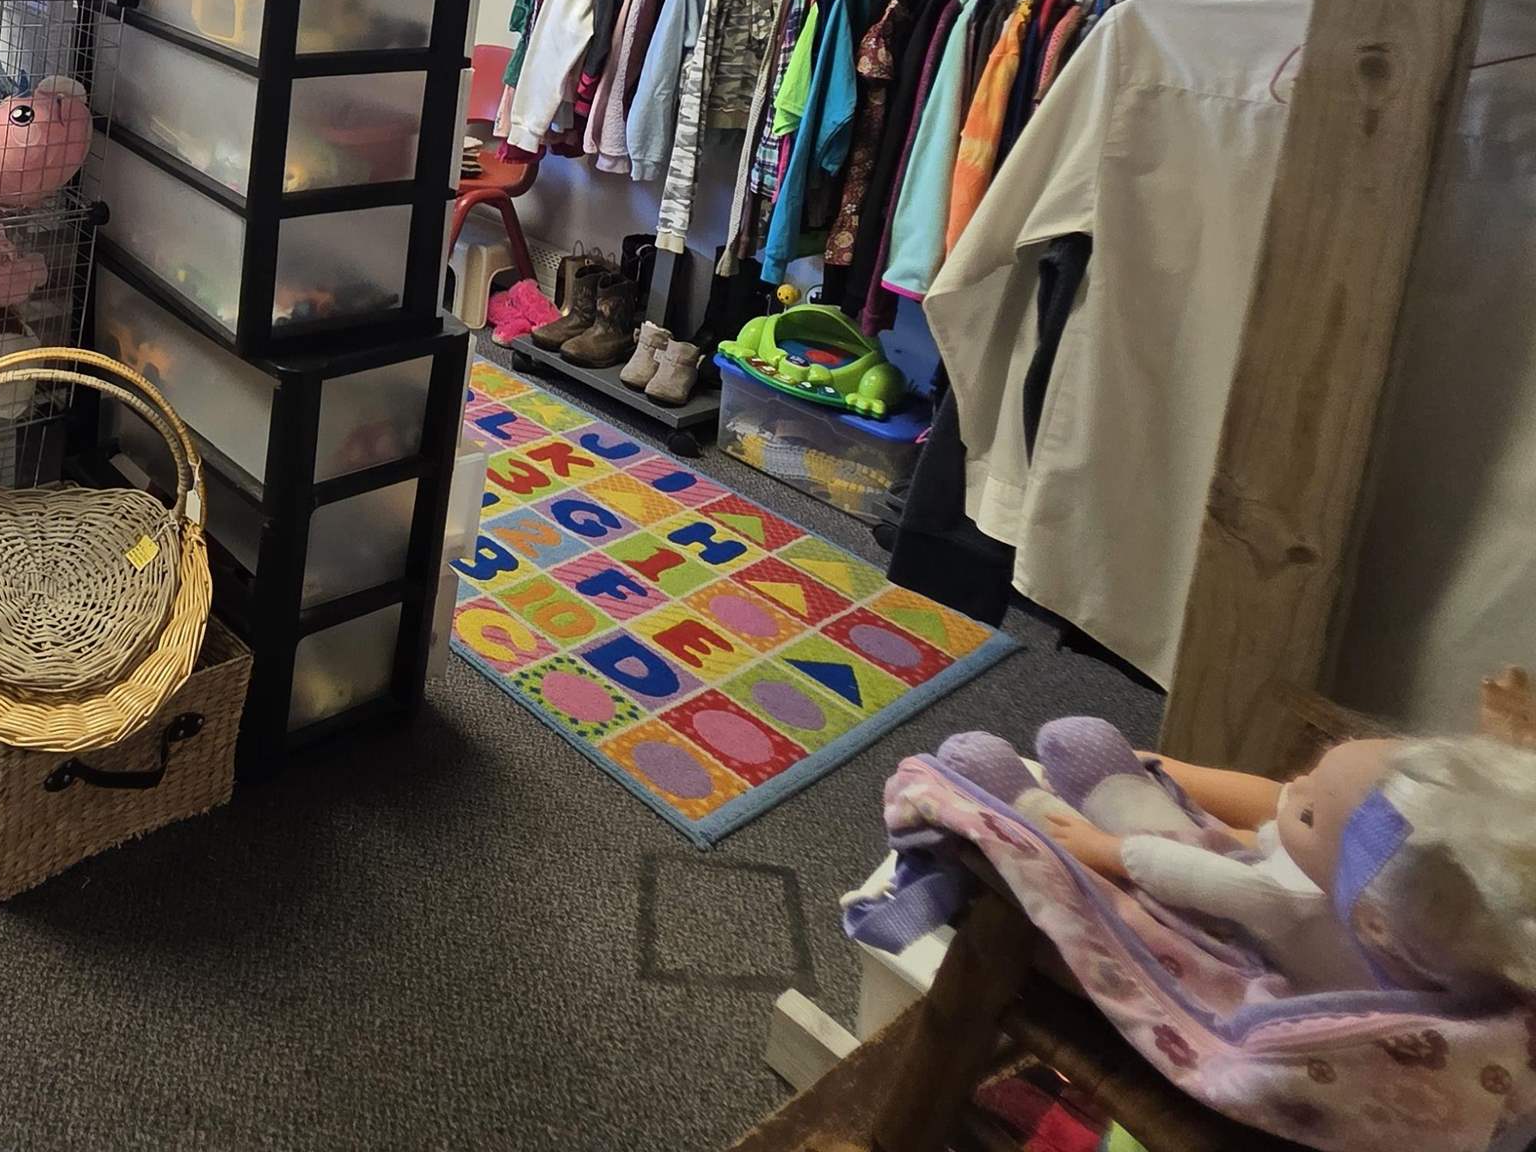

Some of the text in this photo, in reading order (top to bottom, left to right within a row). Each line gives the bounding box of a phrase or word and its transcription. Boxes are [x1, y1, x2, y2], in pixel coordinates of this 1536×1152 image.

[474, 411, 517, 440] L
[526, 442, 595, 477] K
[580, 433, 641, 459] J
[486, 458, 551, 494] 3
[551, 499, 623, 537] G
[491, 519, 562, 558] 2
[667, 522, 747, 565] H
[576, 568, 648, 600] F
[456, 608, 537, 663] C
[653, 619, 735, 668] E
[581, 635, 681, 697] D
